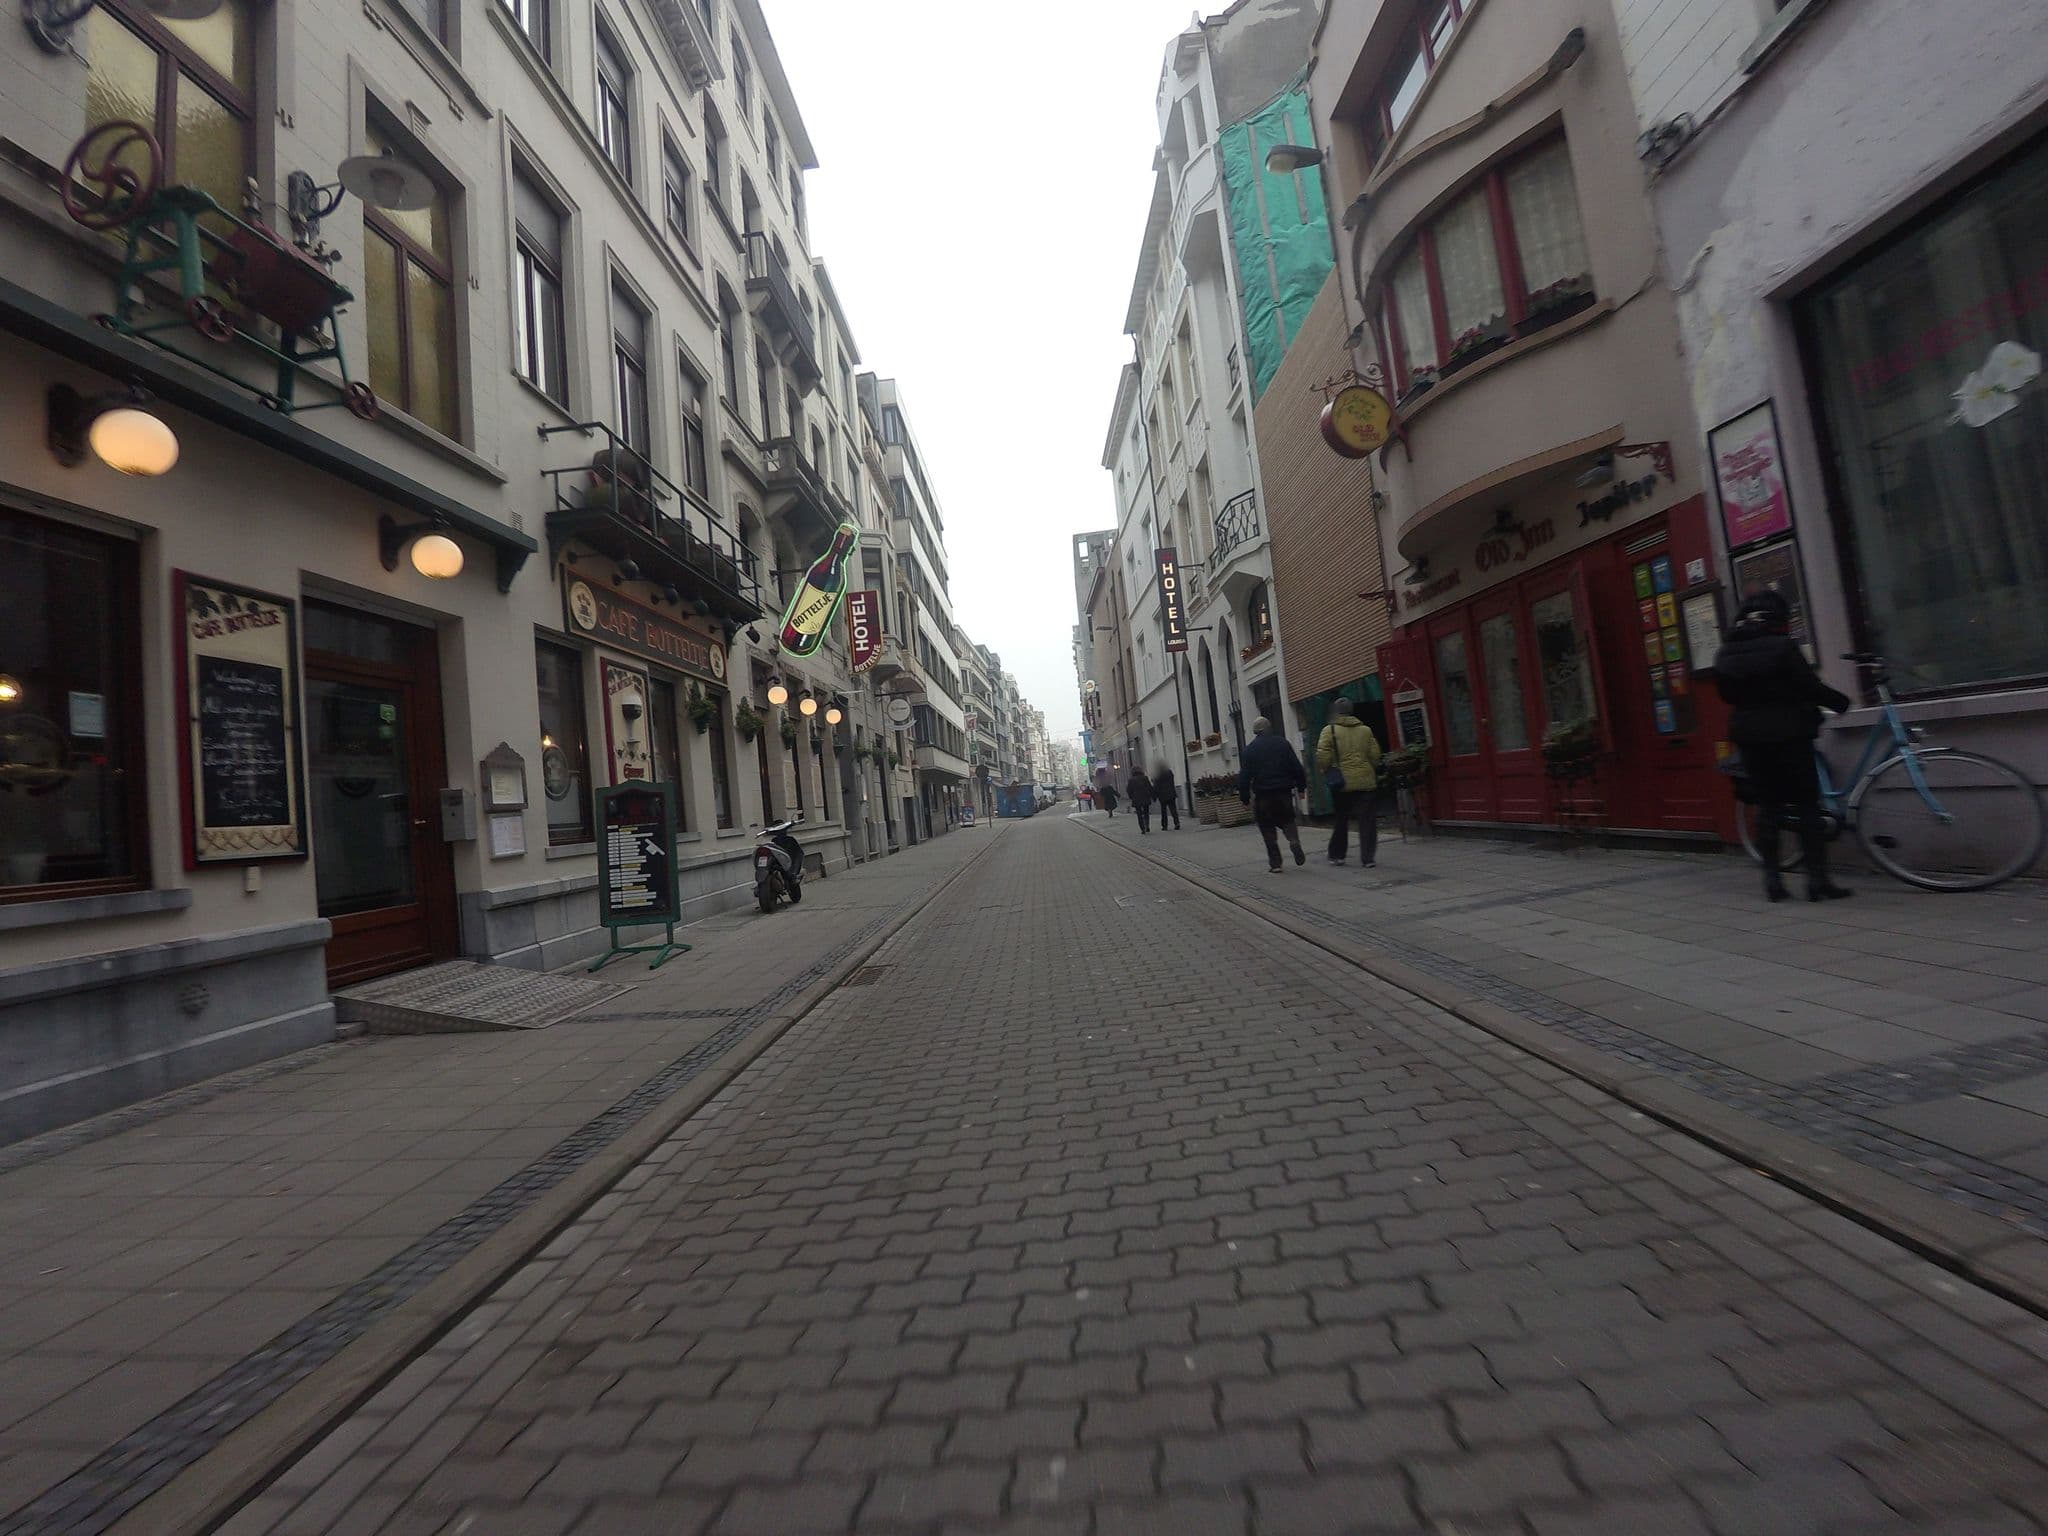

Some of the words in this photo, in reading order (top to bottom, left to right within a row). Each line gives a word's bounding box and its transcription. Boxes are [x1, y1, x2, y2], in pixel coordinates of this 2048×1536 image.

[791, 591, 834, 628] BOTTELTJE
[1161, 561, 1181, 635] HOTEL
[852, 593, 870, 653] HOTEL
[854, 643, 881, 673] BOTTELTJE
